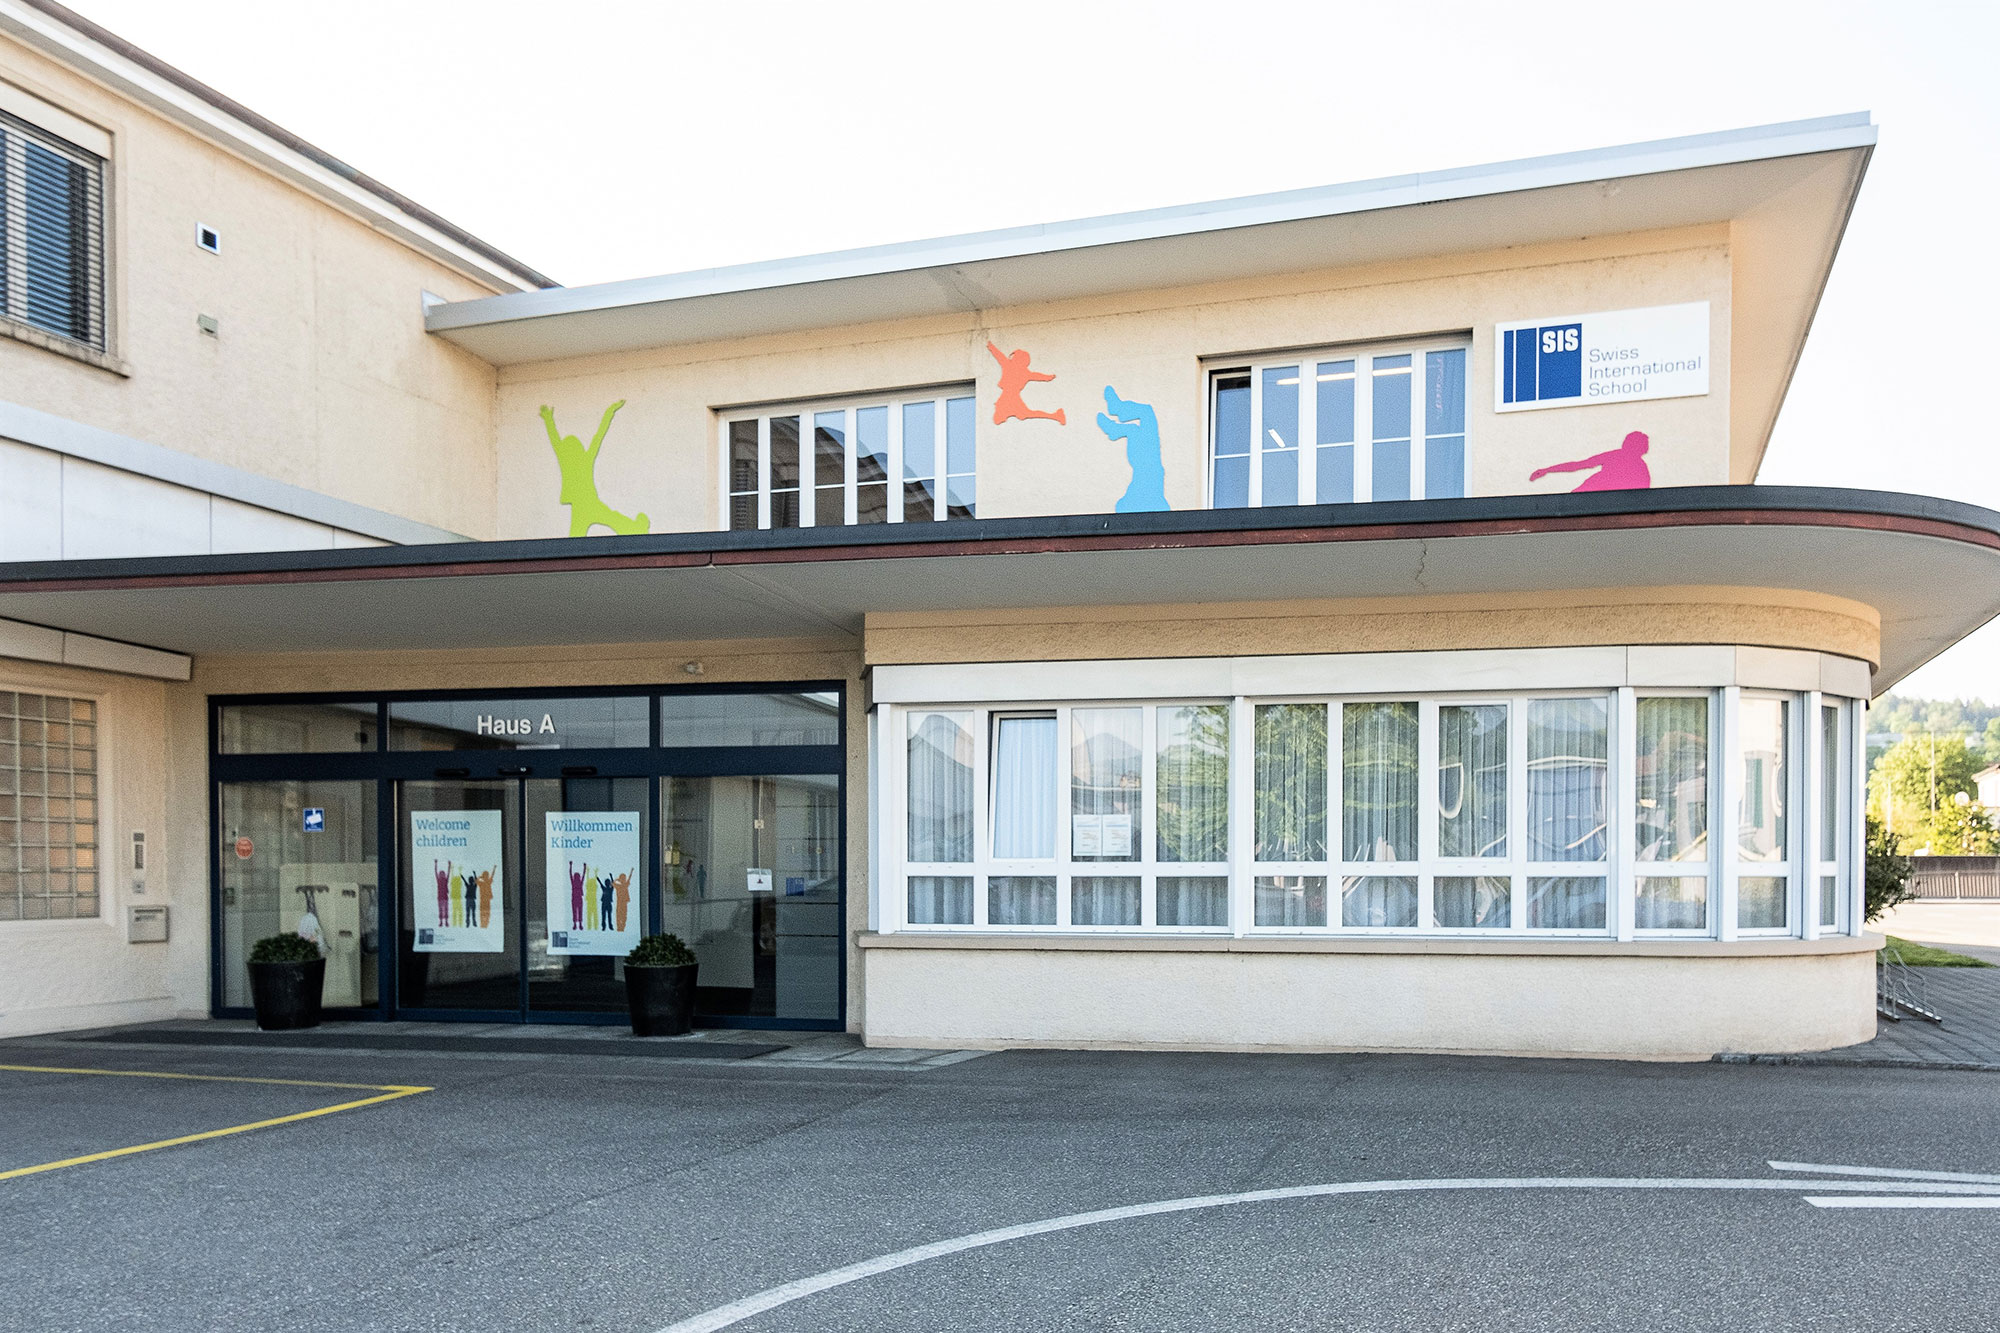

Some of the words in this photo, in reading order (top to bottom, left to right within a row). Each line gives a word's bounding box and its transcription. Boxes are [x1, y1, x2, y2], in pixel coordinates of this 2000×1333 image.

[1542, 328, 1579, 354] SIS
[1589, 347, 1639, 364] Swiss
[1589, 356, 1702, 380] International
[1588, 379, 1648, 397] School
[477, 714, 532, 735] Haus
[539, 713, 556, 734] A
[416, 818, 471, 831] Welcome
[551, 819, 633, 832] Willkommen
[416, 834, 468, 847] children
[551, 836, 594, 848] Kinder
